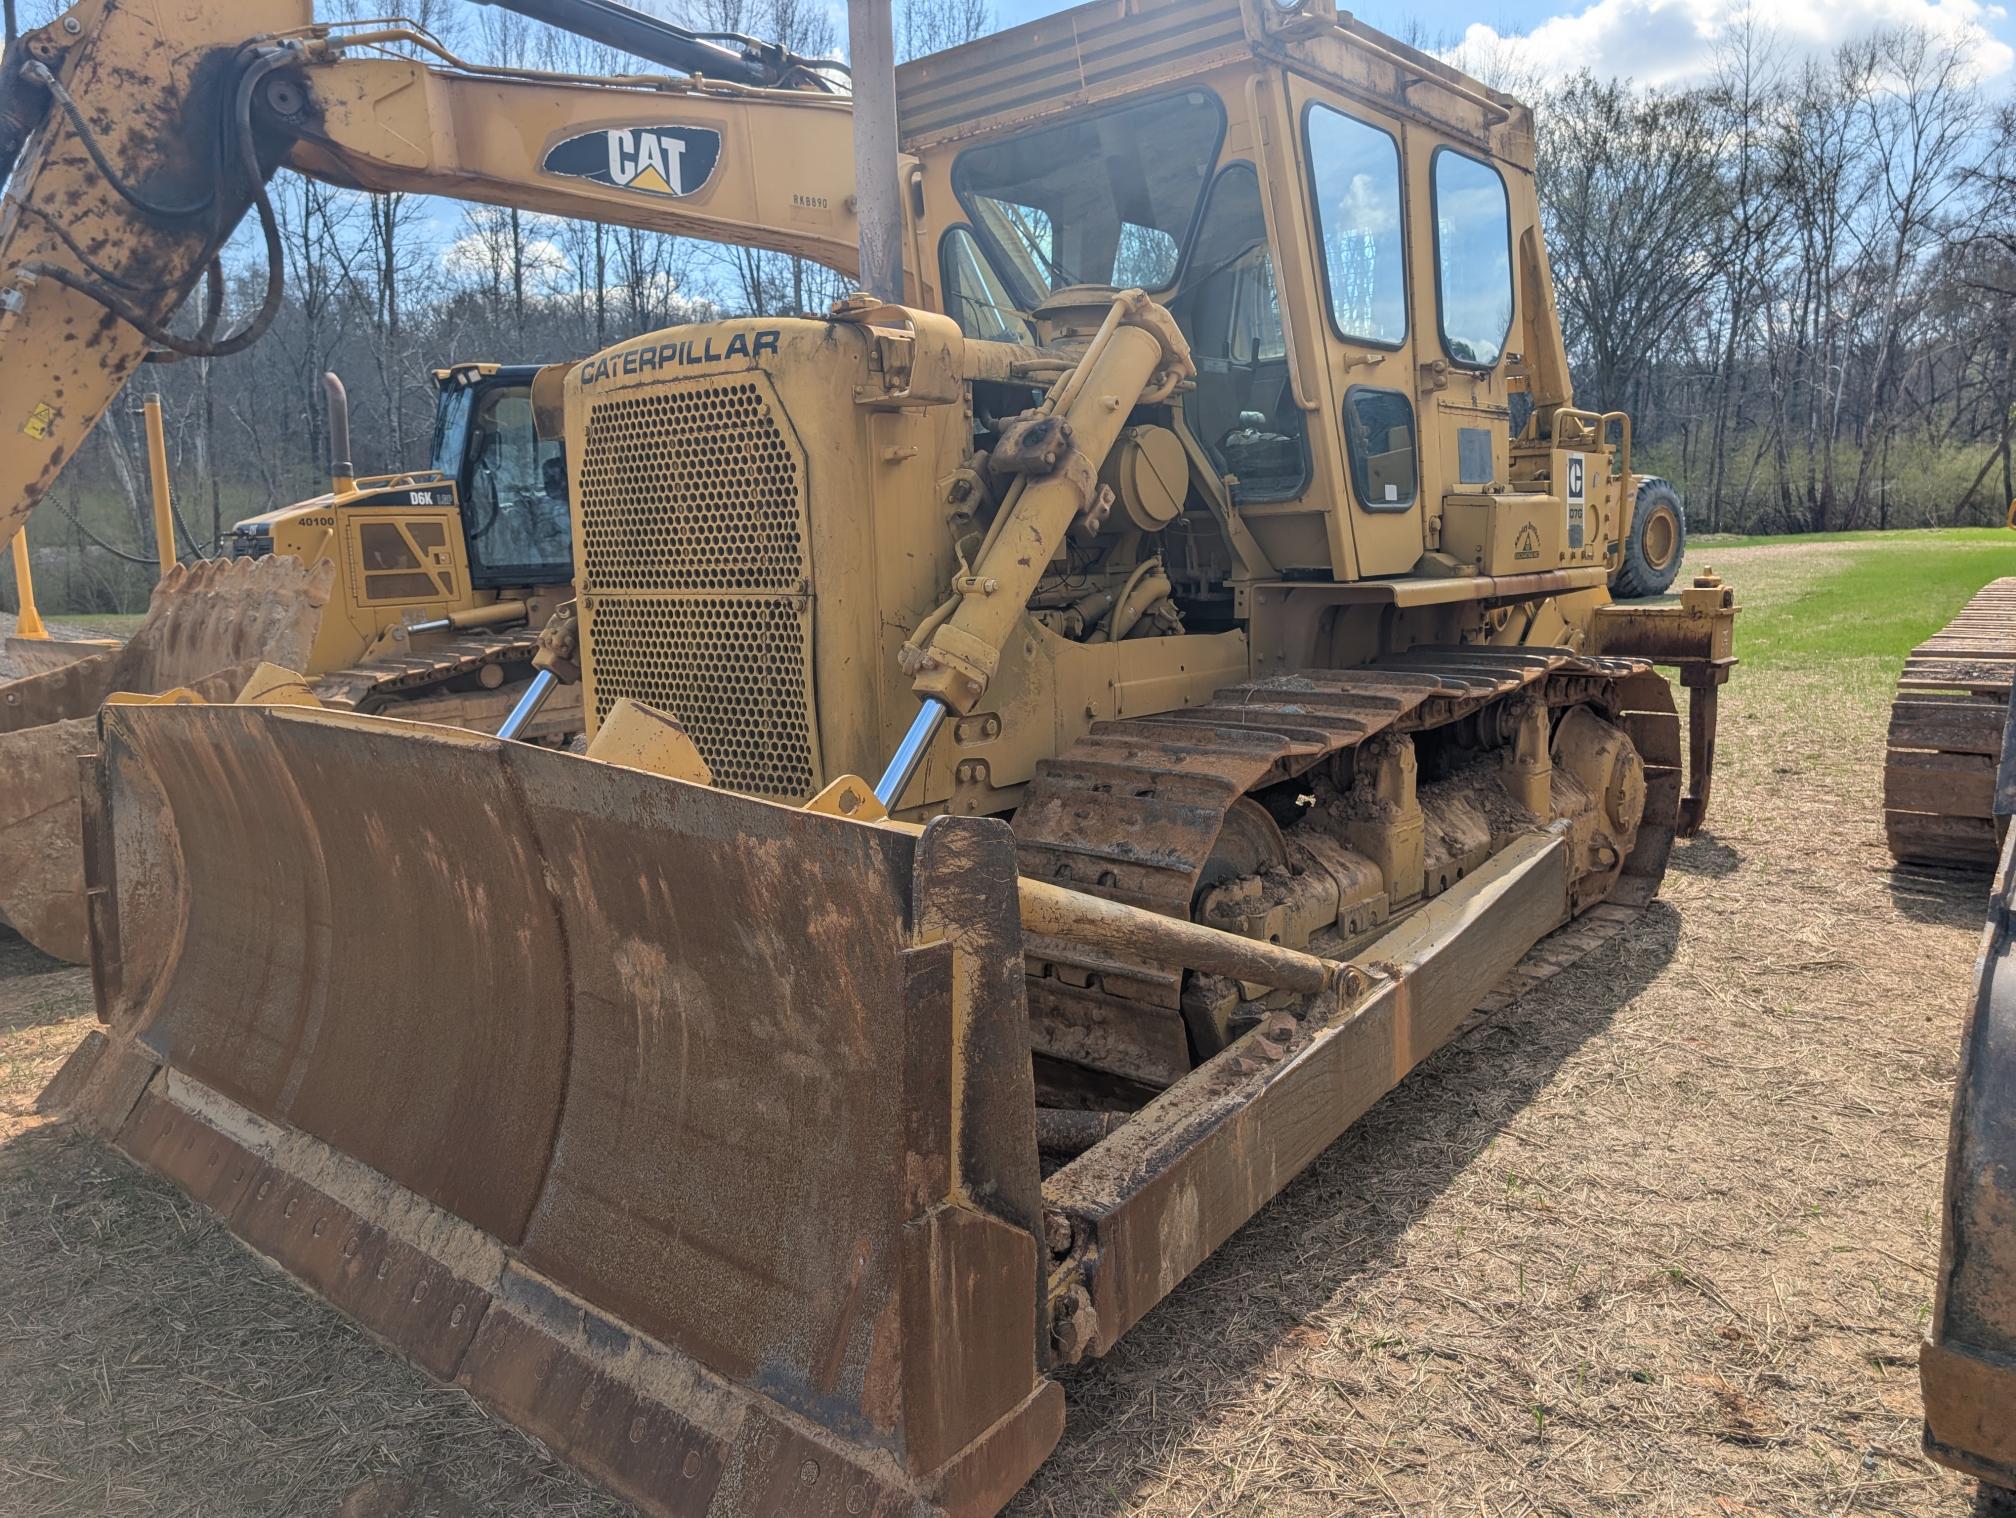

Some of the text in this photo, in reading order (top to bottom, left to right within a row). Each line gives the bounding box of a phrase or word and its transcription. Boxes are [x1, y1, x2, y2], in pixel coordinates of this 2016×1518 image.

[607, 129, 686, 196] CAT
[580, 330, 781, 385] CATERPILLAR
[410, 491, 433, 505] D6K
[1569, 508, 1583, 519] D7G
[298, 517, 335, 527] 40100
